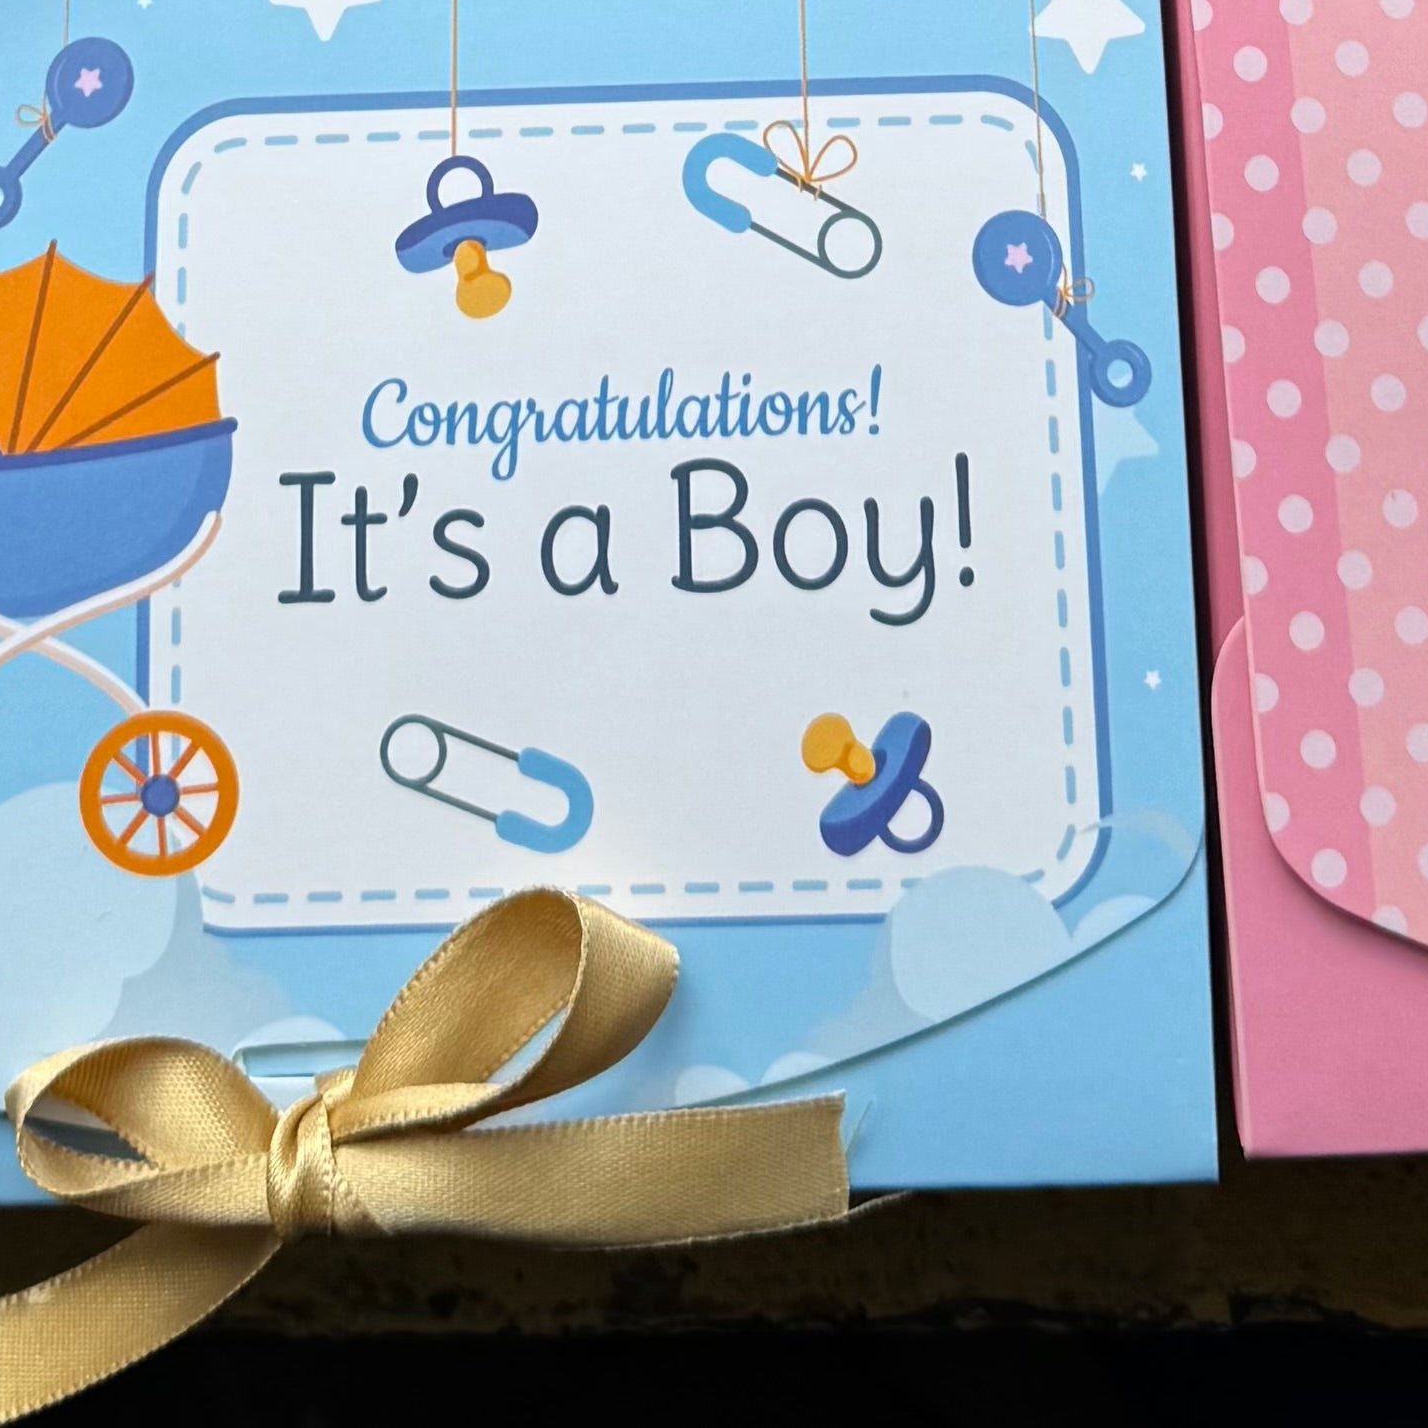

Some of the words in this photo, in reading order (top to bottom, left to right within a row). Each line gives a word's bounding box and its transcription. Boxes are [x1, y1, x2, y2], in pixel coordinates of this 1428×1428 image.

[362, 364, 882, 481] Congratulations!
[278, 471, 490, 604] It's
[540, 504, 619, 596] a
[671, 452, 975, 626] Boy!
